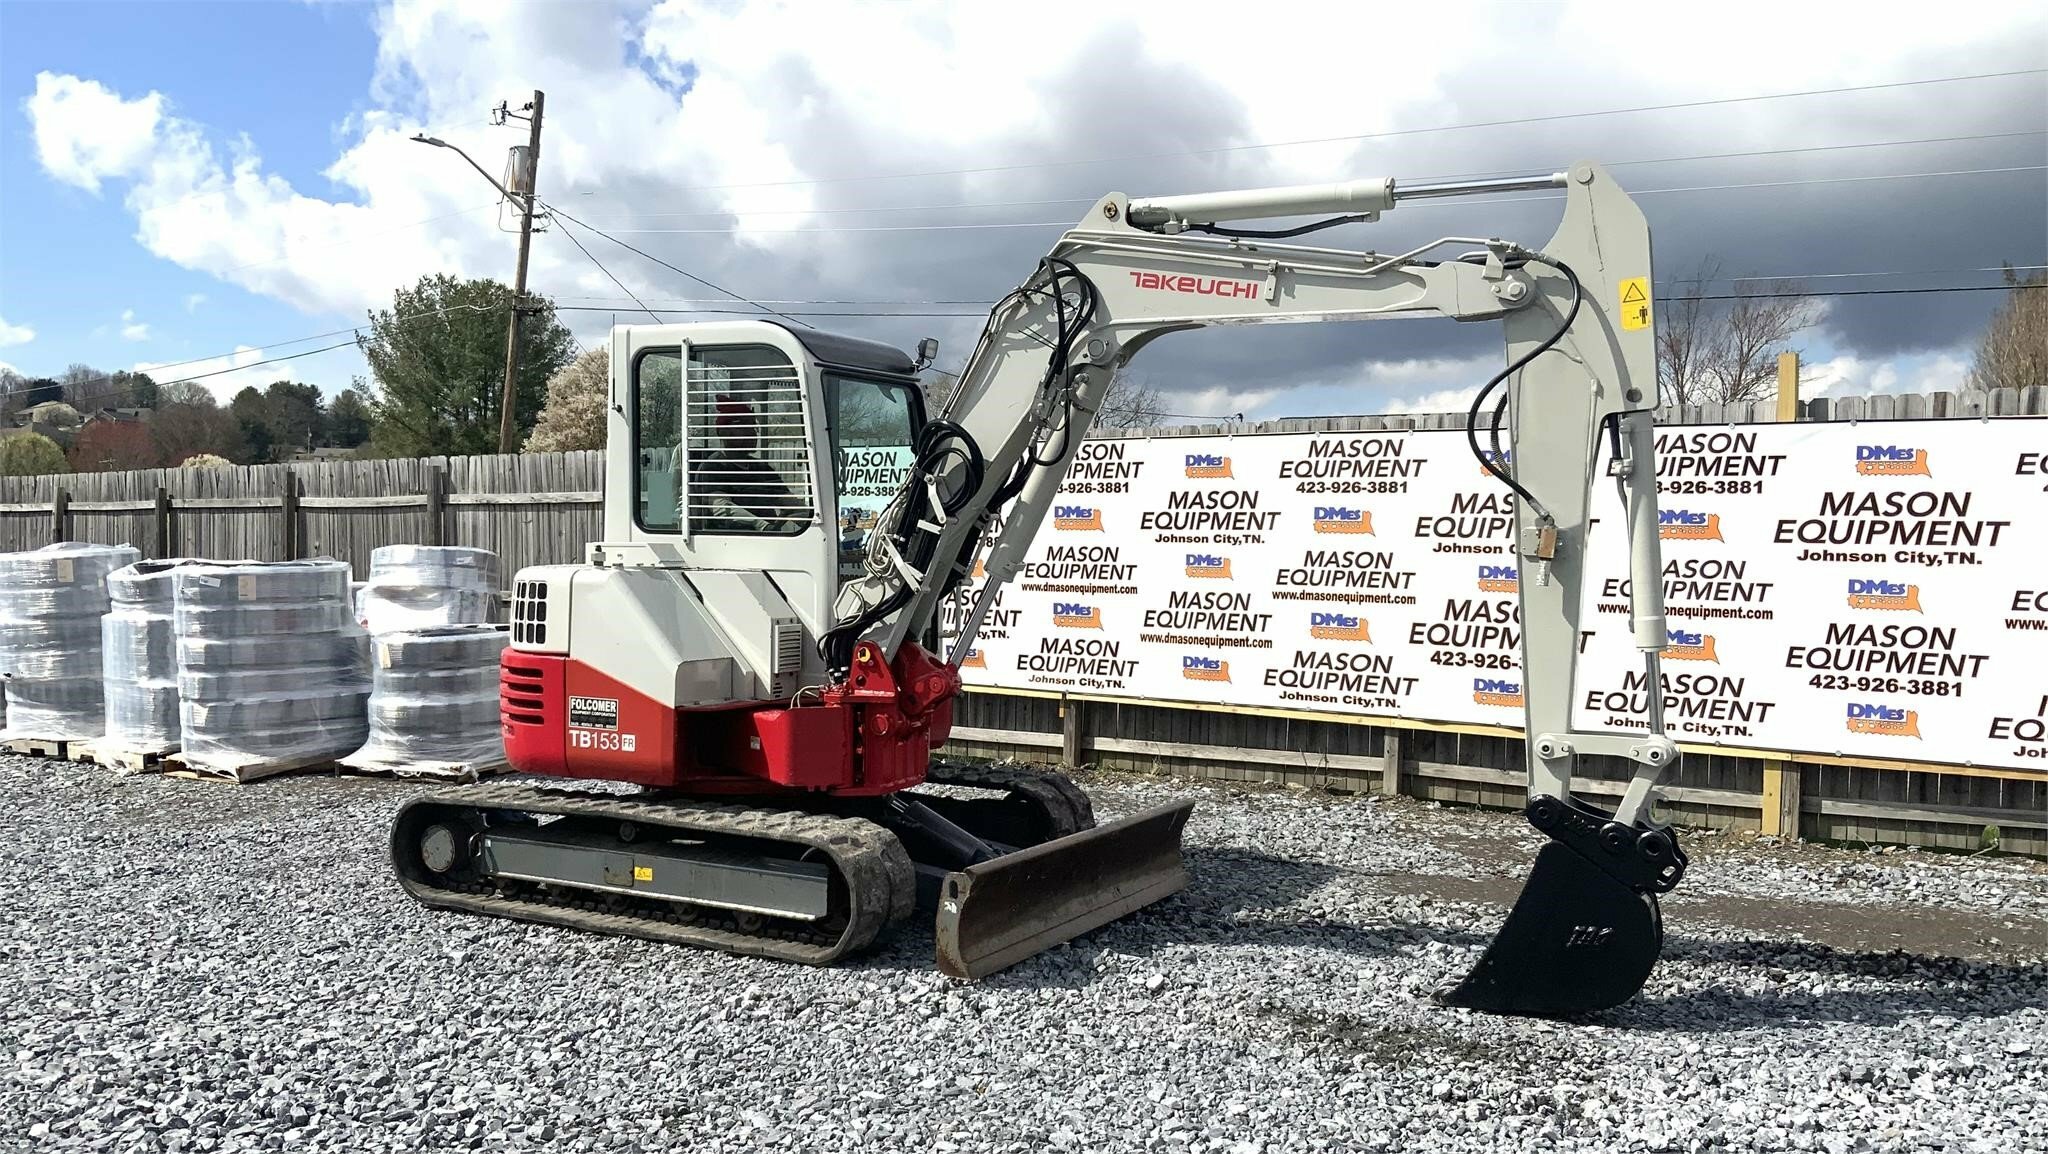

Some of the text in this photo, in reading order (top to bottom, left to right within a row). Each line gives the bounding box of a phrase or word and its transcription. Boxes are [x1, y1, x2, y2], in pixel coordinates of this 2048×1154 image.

[1307, 438, 1404, 458] MASON
[1279, 459, 1427, 480] EQUIPMENT
[1296, 481, 1408, 494] 423-926-3881
[1167, 490, 1259, 510] MASON
[1819, 491, 1972, 517] MASON
[1140, 511, 1282, 530] EQUIPMENT
[1155, 533, 1265, 545] Johnson City,TN.
[1774, 519, 2011, 547] EQUIPMENT
[1046, 546, 1119, 562] MASON
[1433, 542, 1503, 554] Johnson
[1303, 550, 1394, 569] MASON
[1796, 550, 1983, 567] Johnson City,TN.
[1025, 563, 1138, 580] EQUIPMENT
[1275, 569, 1416, 590] EQUIPMENT
[1021, 582, 1138, 595] www.dmasonequipment.com
[1271, 589, 1416, 605] www.dmasonequipment.com
[1168, 591, 1251, 611] MASON
[1143, 609, 1273, 633] EQUIPMENT
[1140, 632, 1273, 649] www.dmasonequipment.com
[1825, 623, 1957, 650] MASON
[1040, 637, 1120, 657] MASON
[1017, 655, 1139, 677] EQUIPMENT
[1293, 650, 1394, 674] MASON
[1785, 646, 1989, 678] EQUIPMENT
[1028, 674, 1125, 689] Johnson City,TN.
[1263, 669, 1419, 696] EQUIPMENT
[1808, 674, 1963, 697] 423-926-3881
[571, 698, 617, 713] FOLCOMER
[1278, 691, 1401, 708] Johnson City,TN.
[1682, 722, 1753, 737] City,TN.
[568, 729, 635, 751] TB153 FR
